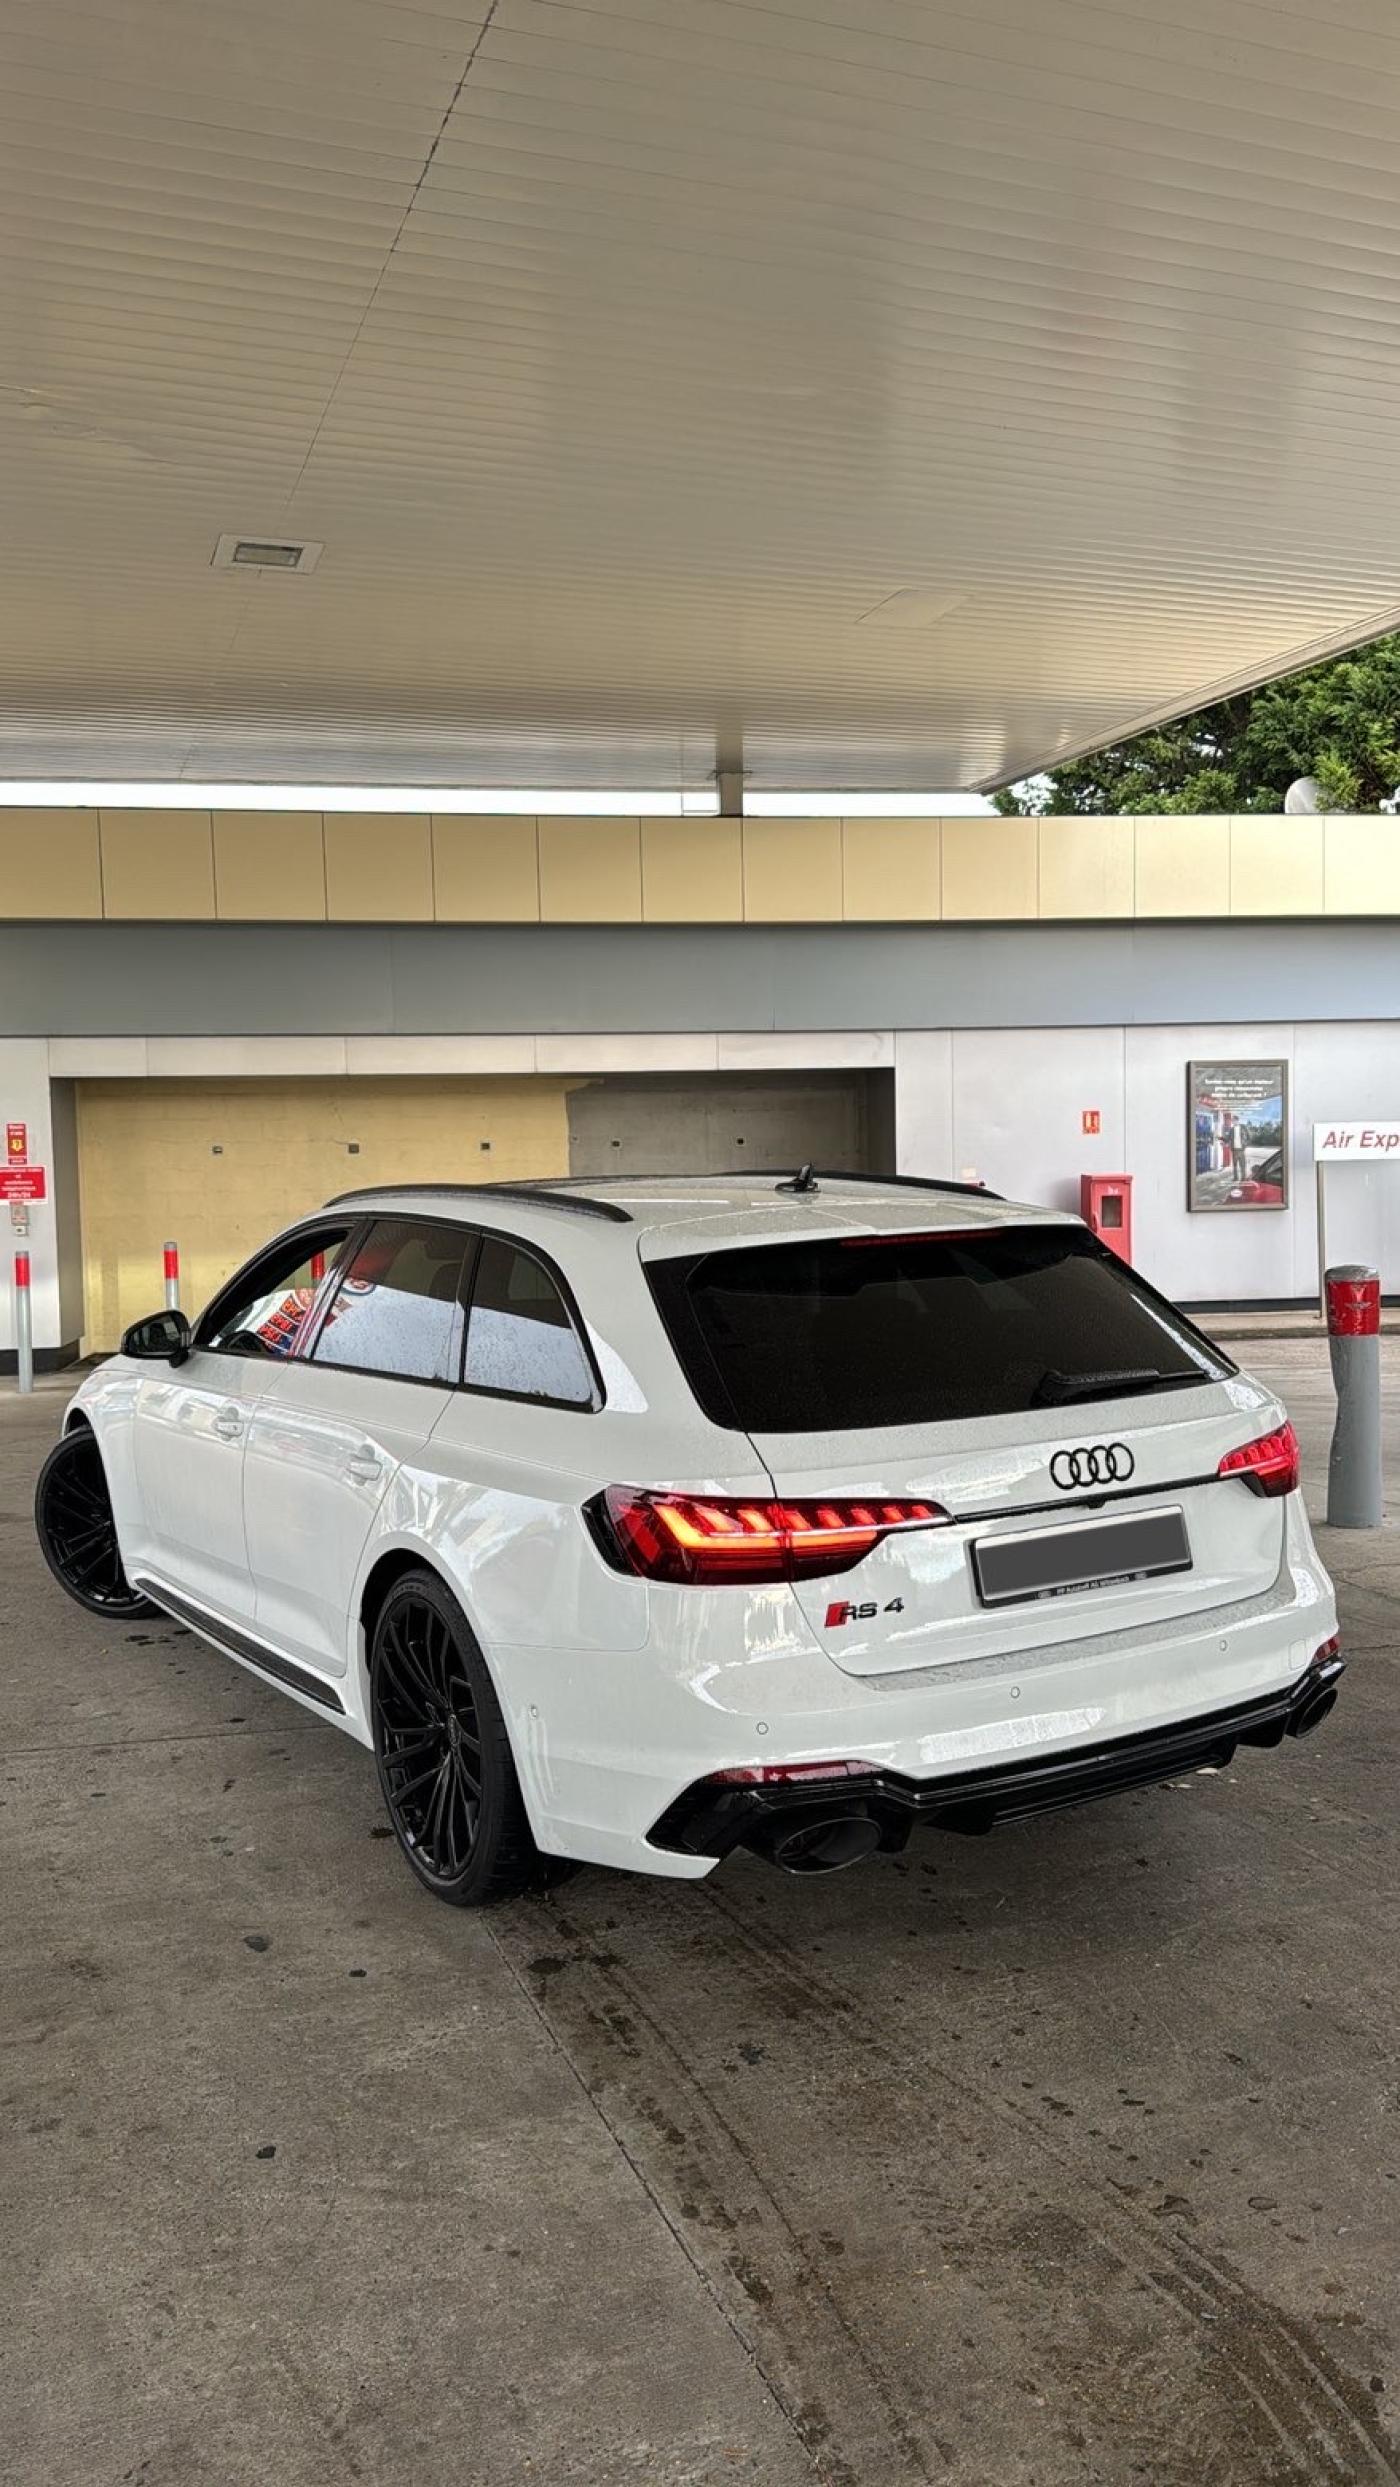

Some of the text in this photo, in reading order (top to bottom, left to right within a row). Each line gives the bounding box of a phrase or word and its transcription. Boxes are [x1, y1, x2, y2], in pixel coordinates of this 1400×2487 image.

[1322, 1130, 1354, 1149] Air
[838, 1597, 905, 1624] RS 4
